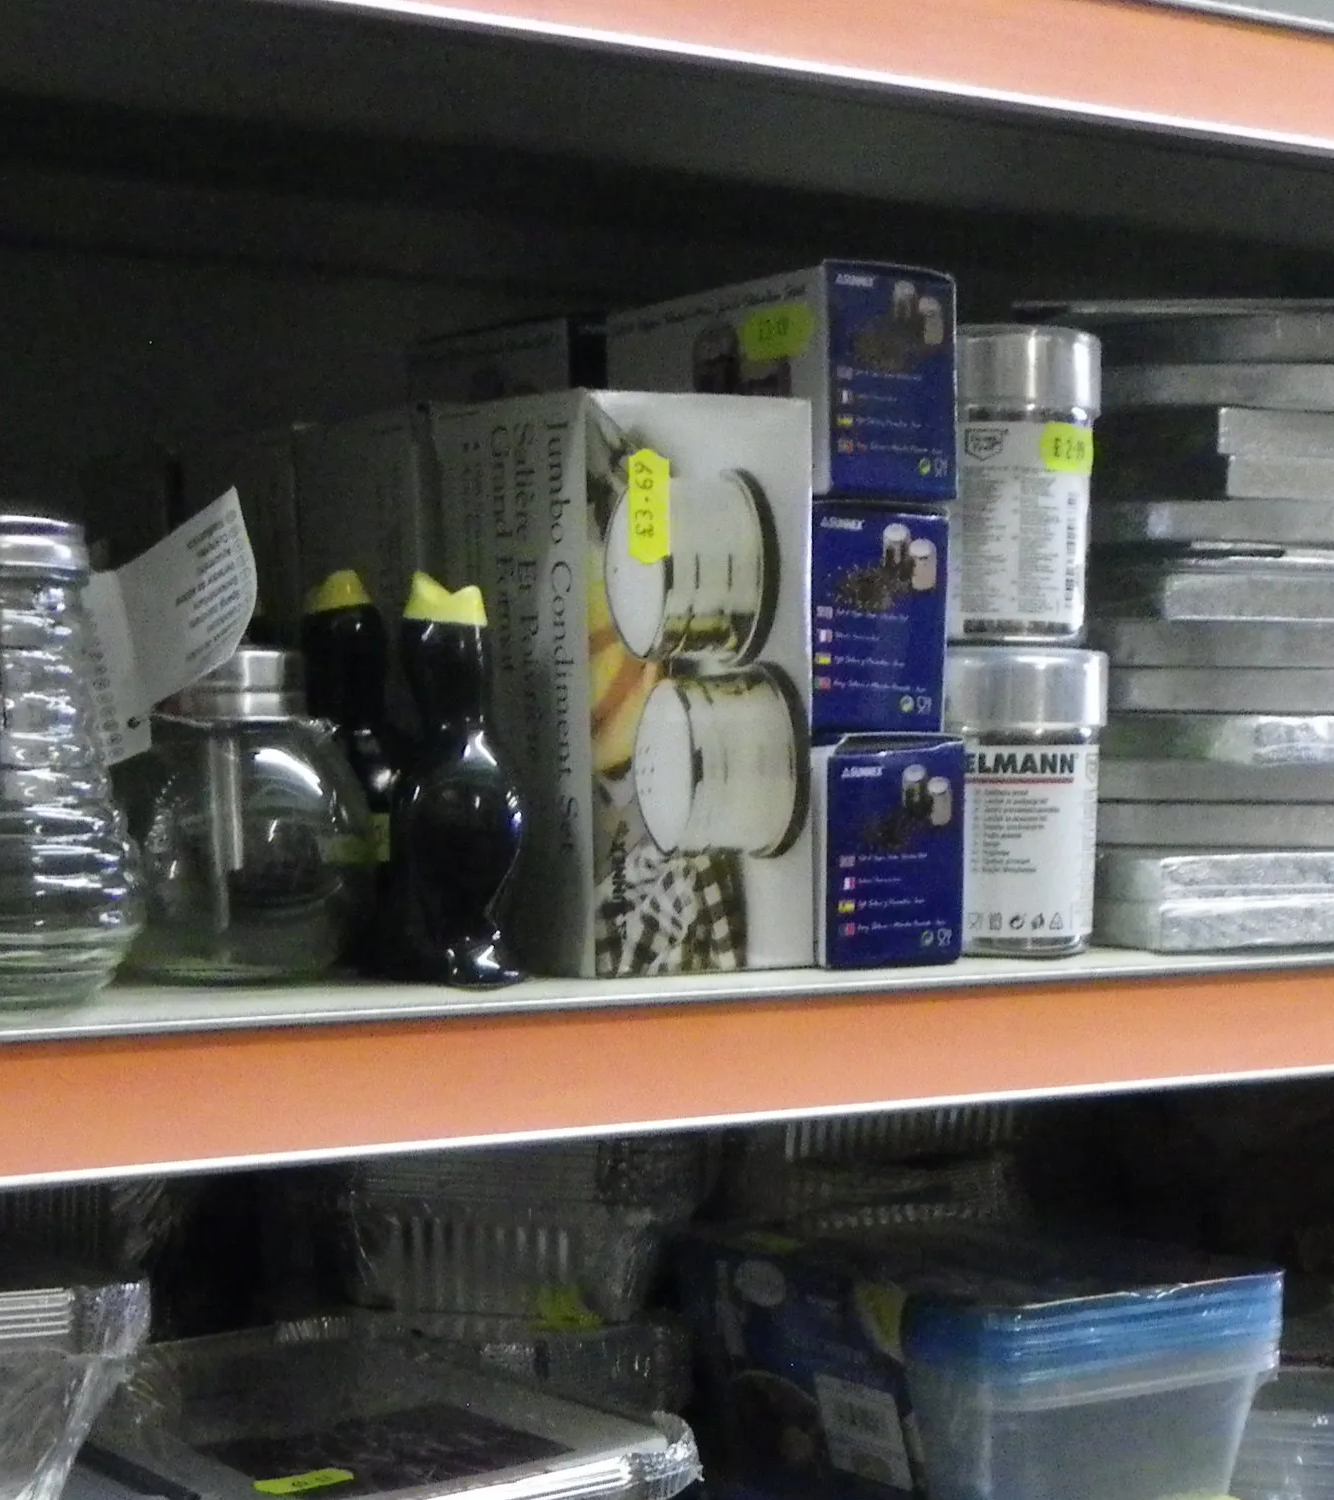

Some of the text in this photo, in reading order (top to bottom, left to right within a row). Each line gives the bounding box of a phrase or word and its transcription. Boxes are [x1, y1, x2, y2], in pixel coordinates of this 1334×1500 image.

[546, 423, 571, 544] Jumbo
[551, 560, 575, 773] Condiment
[965, 752, 1075, 775] ELMANN
